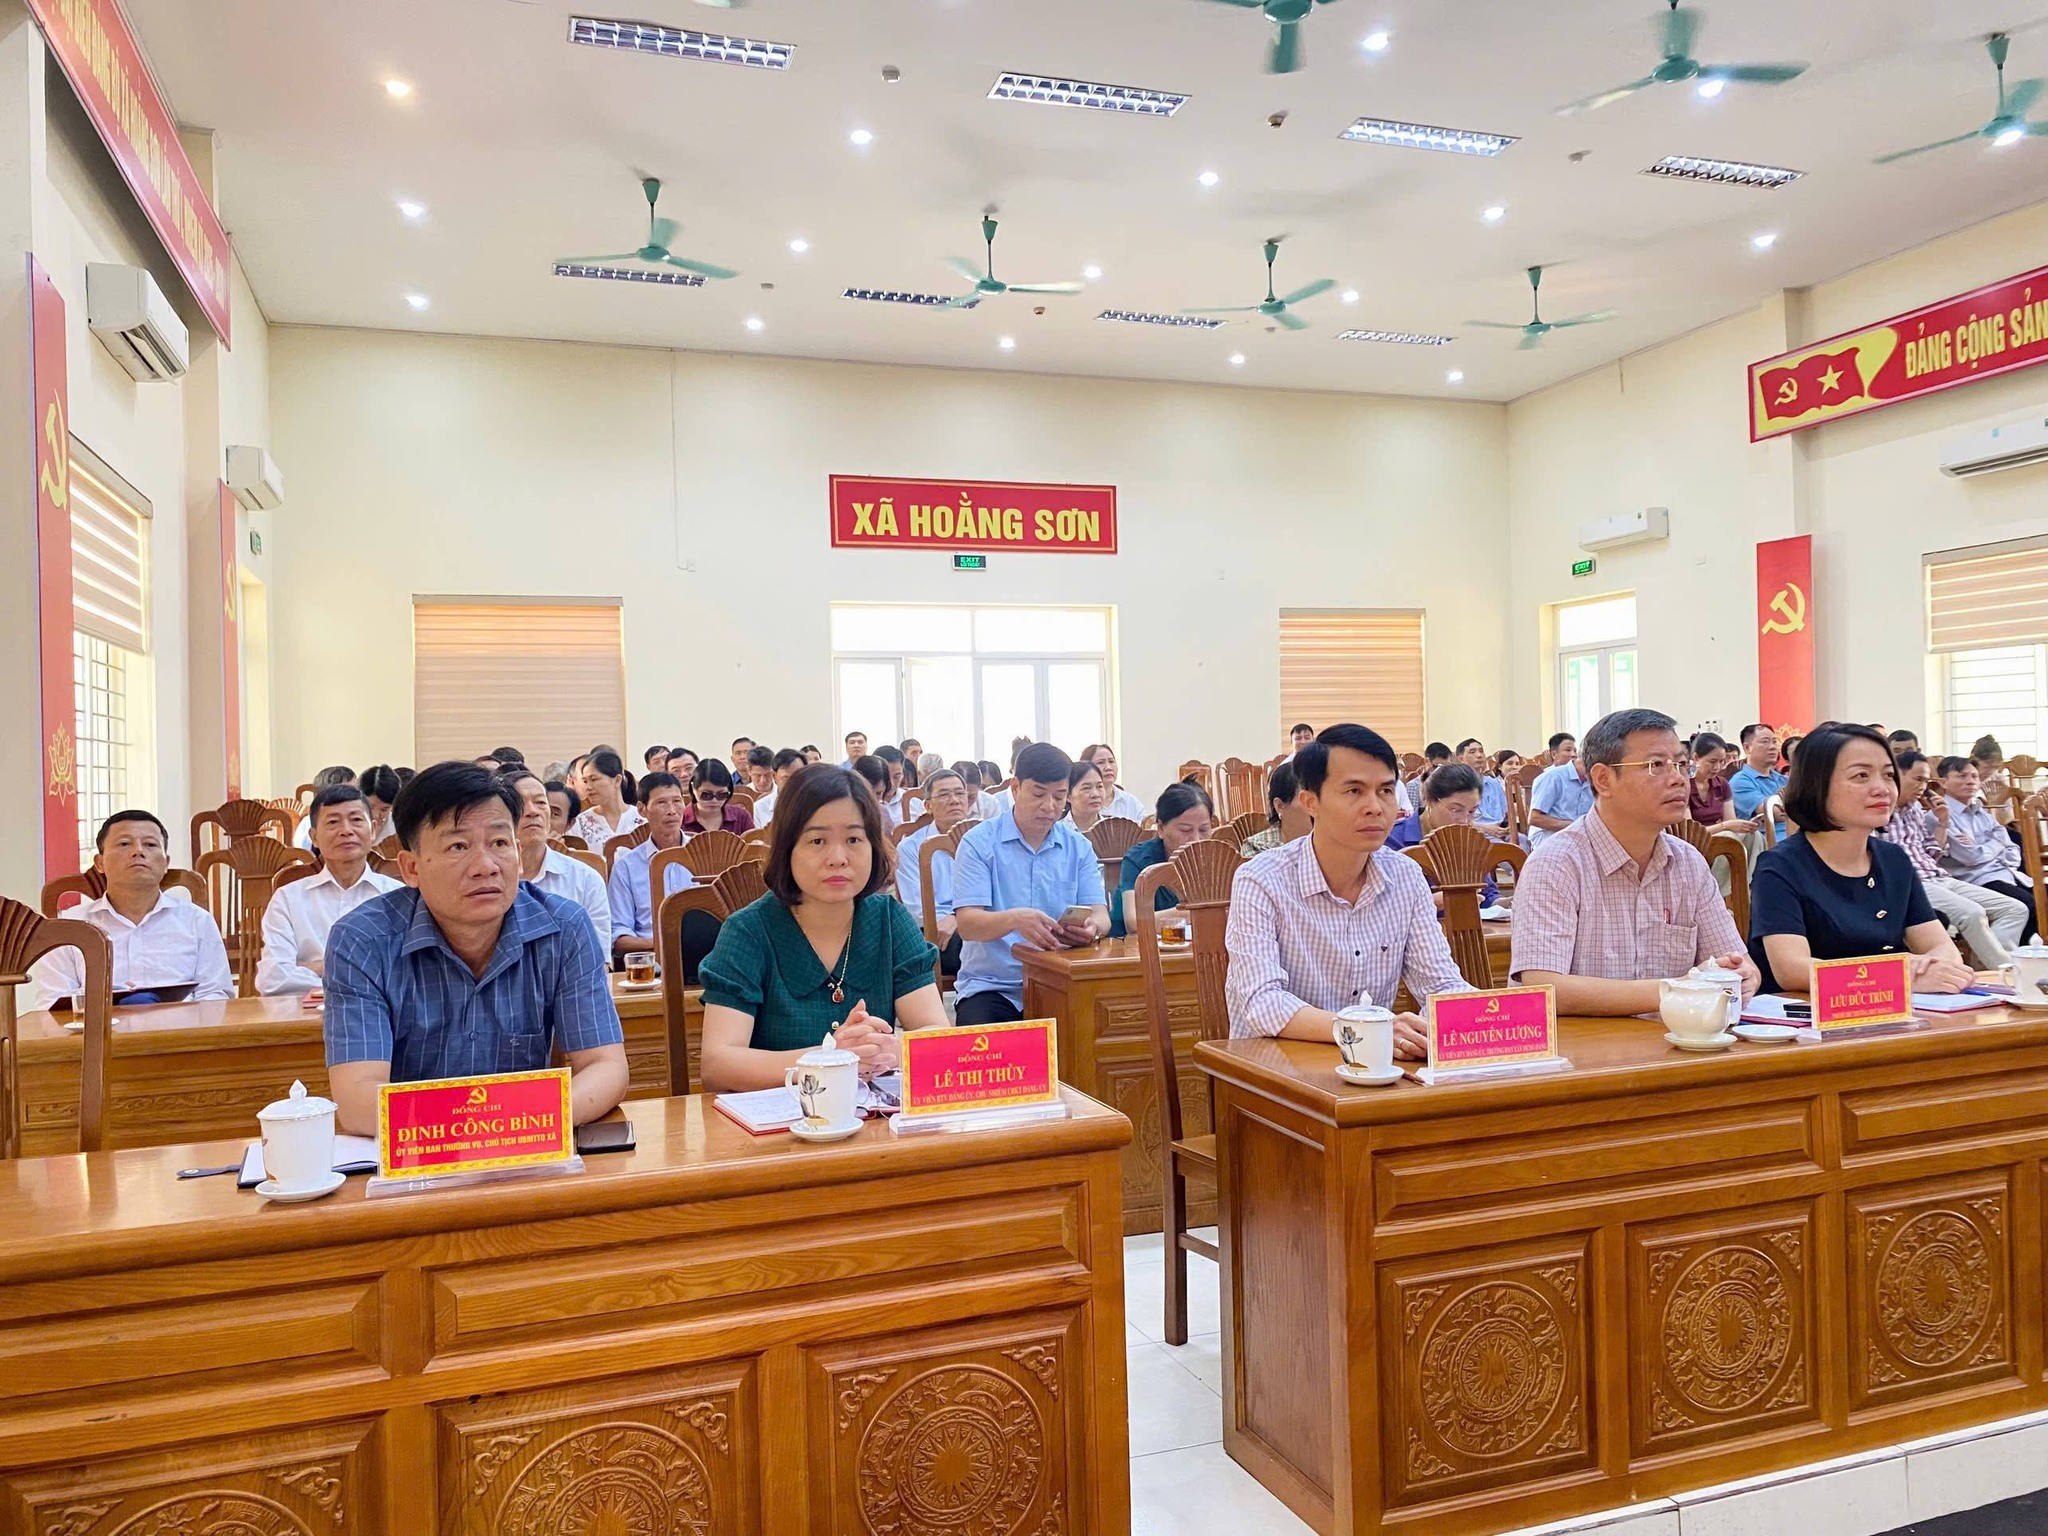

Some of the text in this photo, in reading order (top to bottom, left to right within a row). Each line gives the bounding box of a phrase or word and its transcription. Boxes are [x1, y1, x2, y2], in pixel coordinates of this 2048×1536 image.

[1906, 287, 2048, 379] ĐẢNG CỘNG SẢN
[851, 491, 1100, 542] XÃ HOẰNG SƠN
[1443, 1029, 1458, 1047] LÊ
[934, 1069, 953, 1088] LÊ
[956, 1069, 982, 1088] THỊ
[398, 1112, 555, 1142] ĐINH CÔNG BÌNH
